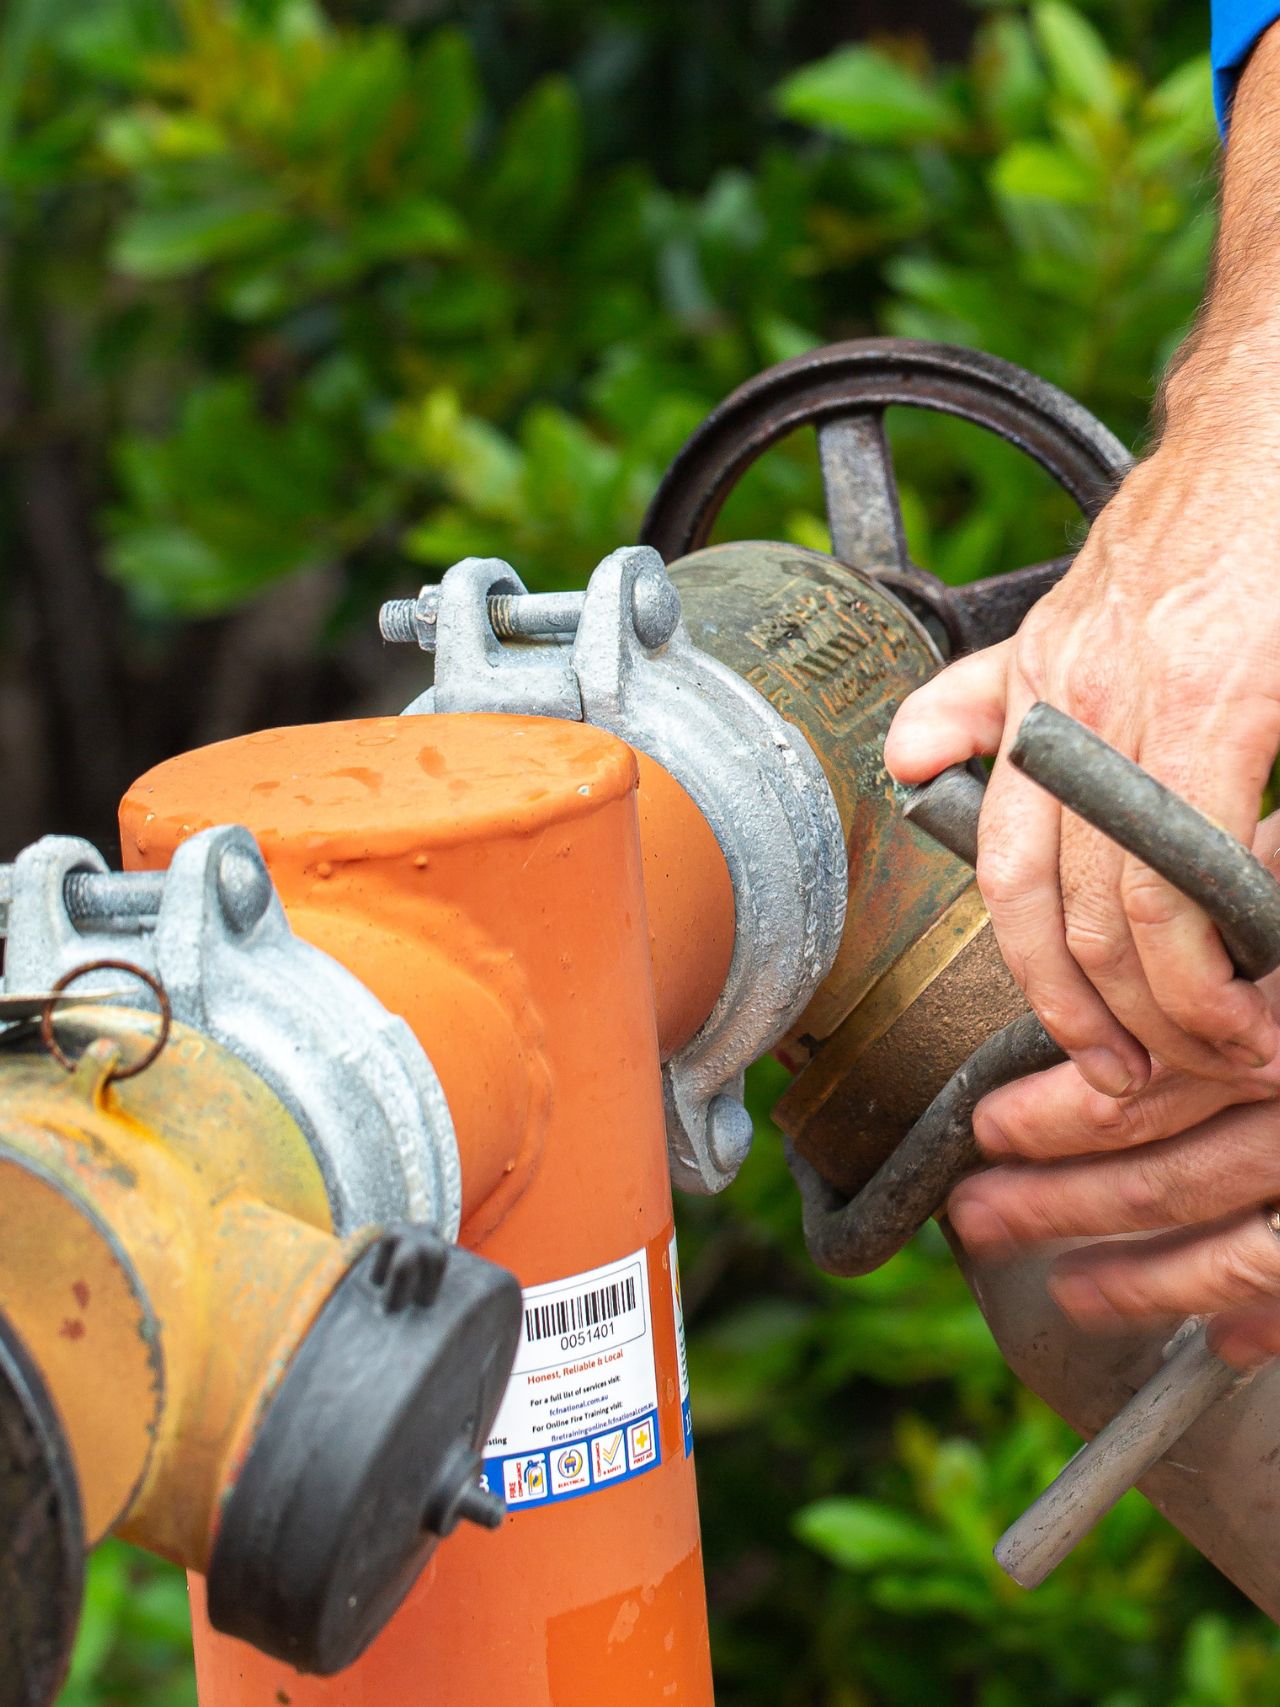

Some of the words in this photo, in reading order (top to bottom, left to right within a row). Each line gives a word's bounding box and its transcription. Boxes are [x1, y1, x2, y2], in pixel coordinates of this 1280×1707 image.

[560, 1322, 614, 1350] 0051401
[527, 1371, 561, 1385] Honest,
[563, 1359, 596, 1376] Reliable
[604, 1349, 624, 1363] Local
[530, 1399, 542, 1407] For
[550, 1394, 562, 1403] full
[575, 1387, 581, 1397] of
[583, 1382, 607, 1393] services
[532, 1425, 544, 1433] For
[546, 1419, 569, 1430] Online
[570, 1415, 583, 1424] Fire
[585, 1406, 609, 1420] Training
[488, 1437, 507, 1446] sting
